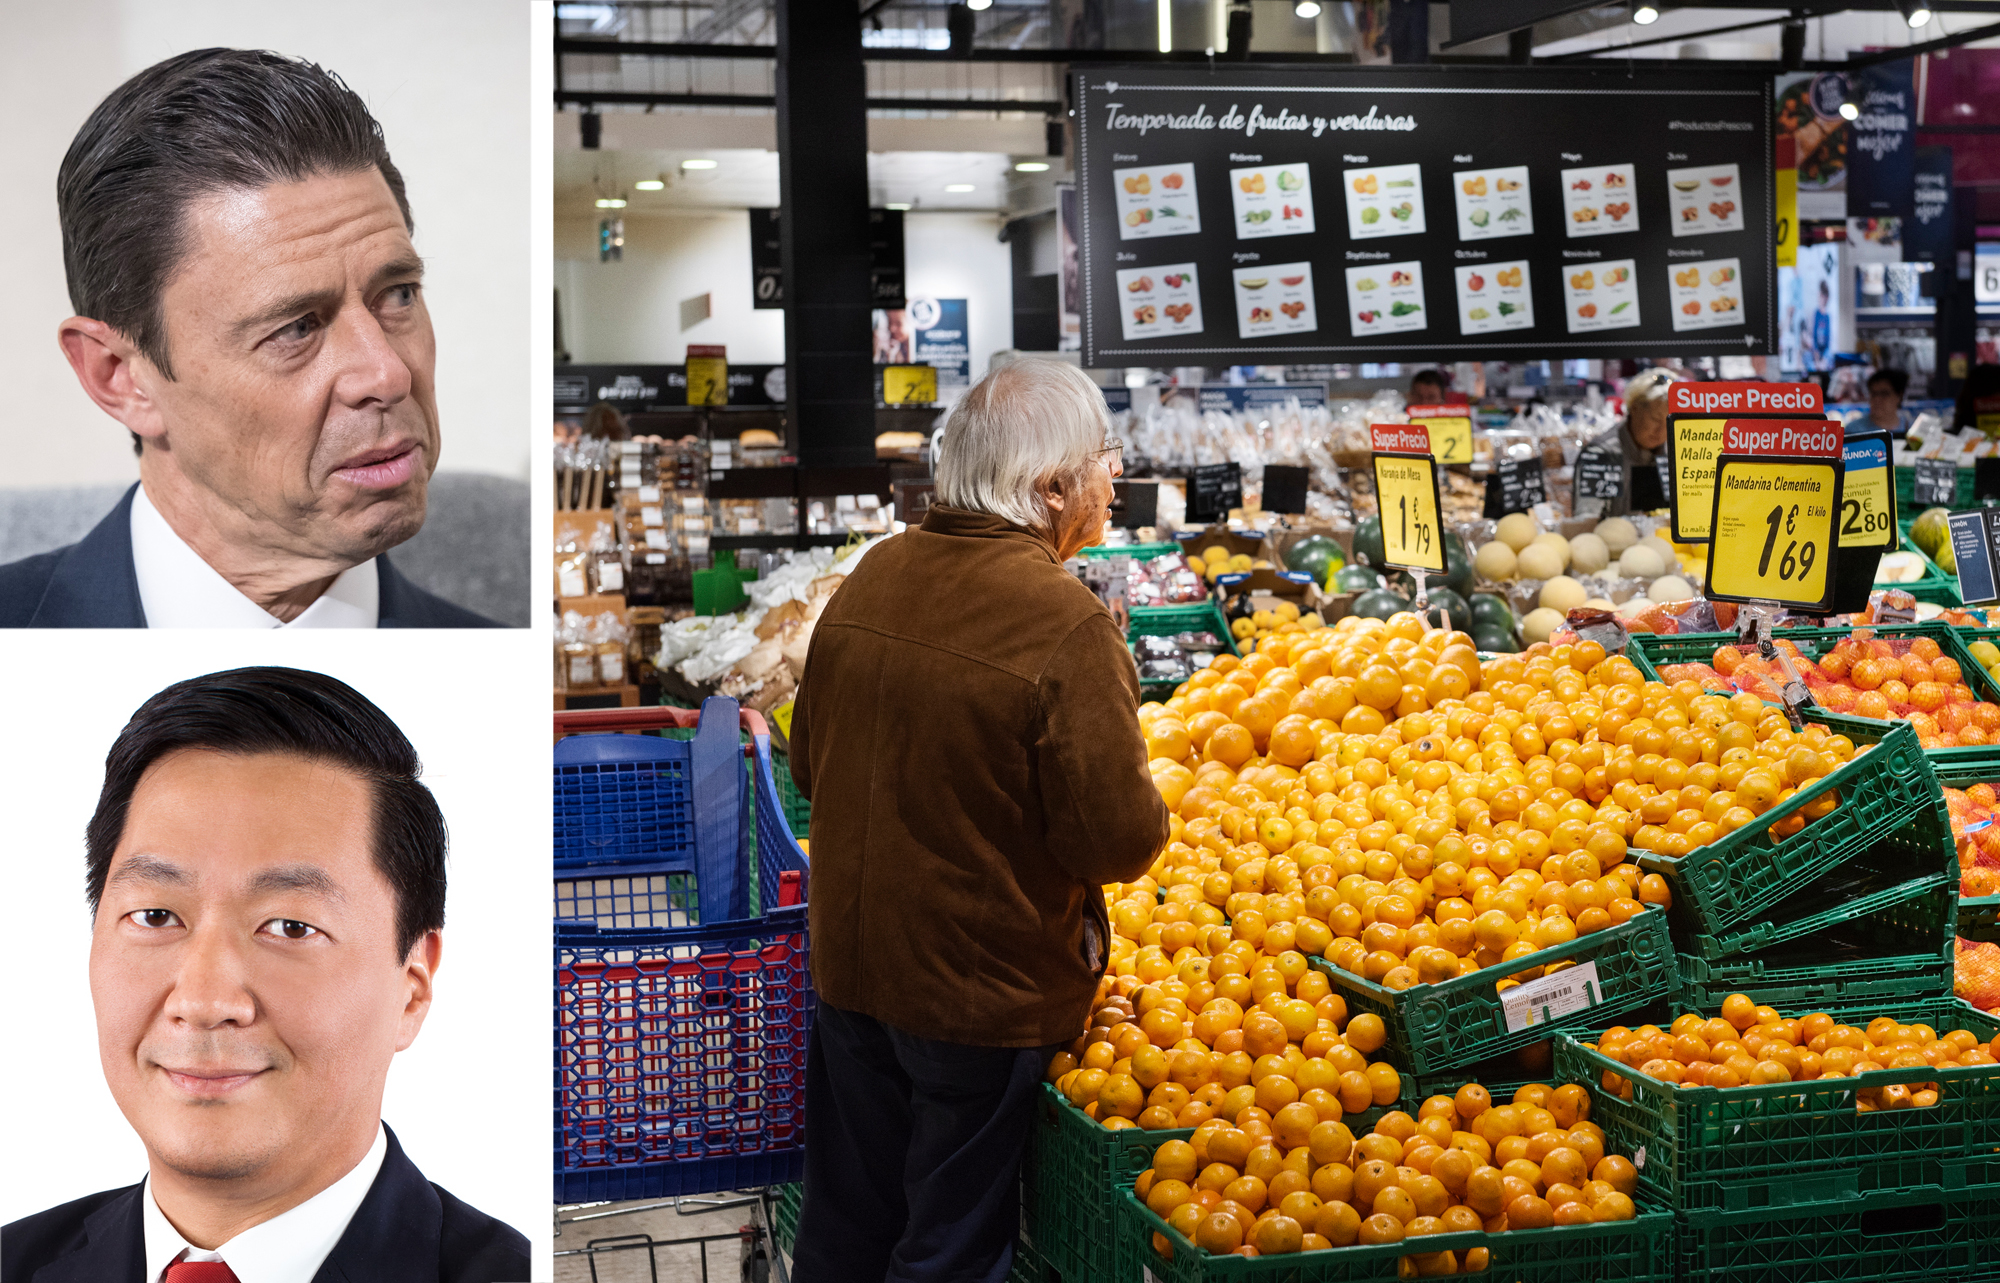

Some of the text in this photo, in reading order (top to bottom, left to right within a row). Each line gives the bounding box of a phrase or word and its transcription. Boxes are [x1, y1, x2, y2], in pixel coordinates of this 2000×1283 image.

[1106, 103, 1417, 137] Temporada de frutas y verduras
[1668, 120, 1754, 131] #ProductosFrescos
[1113, 153, 1138, 162] Enero
[1229, 152, 1263, 162] Febrero
[1343, 154, 1369, 163] Marzo
[1453, 154, 1473, 163] Abril
[1560, 152, 1583, 163] Mayo
[1667, 152, 1688, 161] Junio
[1116, 252, 1137, 261] Julio
[1232, 252, 1261, 263] Agosto
[1345, 251, 1391, 261] Septiembre
[1454, 249, 1488, 259] Octubre
[1562, 249, 1601, 258] Noviembre
[1667, 248, 1705, 257] Diciembre
[1677, 387, 1815, 413] Super Precio
[1373, 428, 1429, 450] Super Precio
[1728, 426, 1837, 454] Super Precio
[1443, 437, 1456, 459] 2
[1681, 447, 1713, 460] Malla
[1379, 465, 1422, 482] Naranja de Mesa
[1725, 475, 1821, 492] Mandarina Clementina
[1398, 494, 1407, 551] 1
[1841, 498, 1872, 535] 2 €
[1864, 512, 1888, 533] 80
[1951, 520, 1968, 528] LIMÓN
[1414, 523, 1430, 555] 79
[1757, 503, 1827, 578] 1 € El kilo
[1779, 541, 1816, 582] 69
[1503, 993, 1530, 1005] Quality
